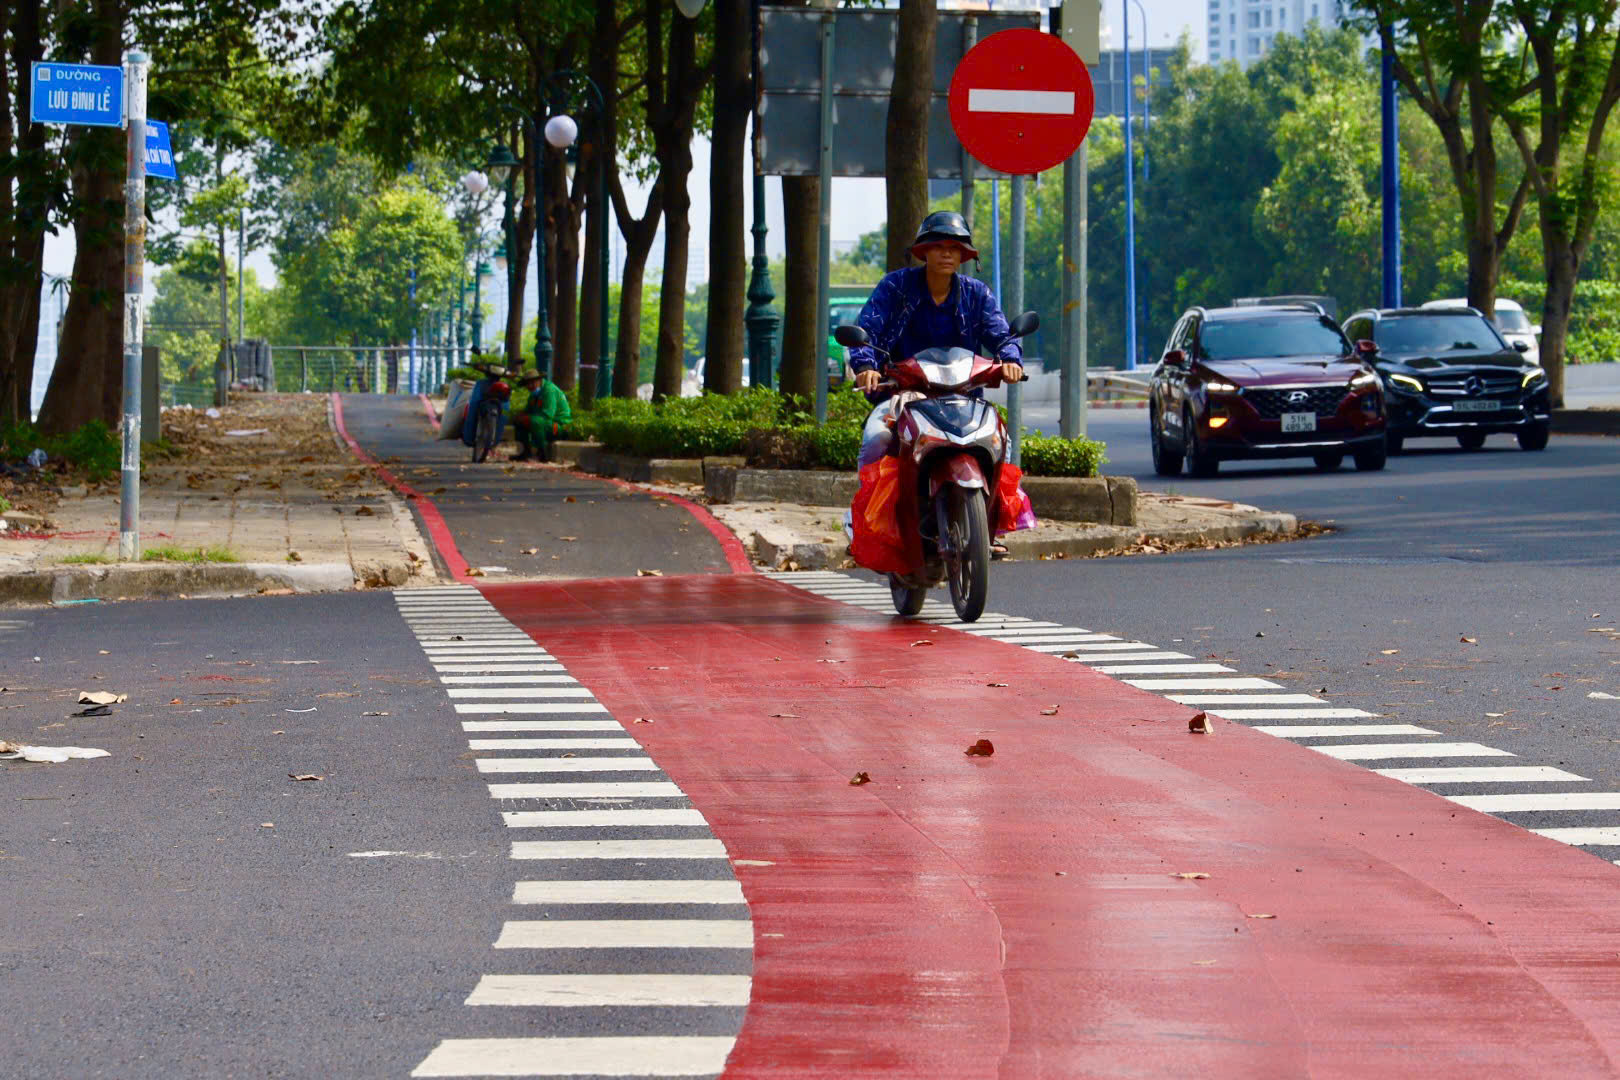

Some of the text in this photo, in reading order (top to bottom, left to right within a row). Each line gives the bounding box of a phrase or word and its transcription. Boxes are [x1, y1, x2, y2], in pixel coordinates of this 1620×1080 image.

[56, 69, 101, 81] ĐƯỜNG
[48, 87, 69, 110] LƯU
[71, 87, 95, 111] ĐÌNH
